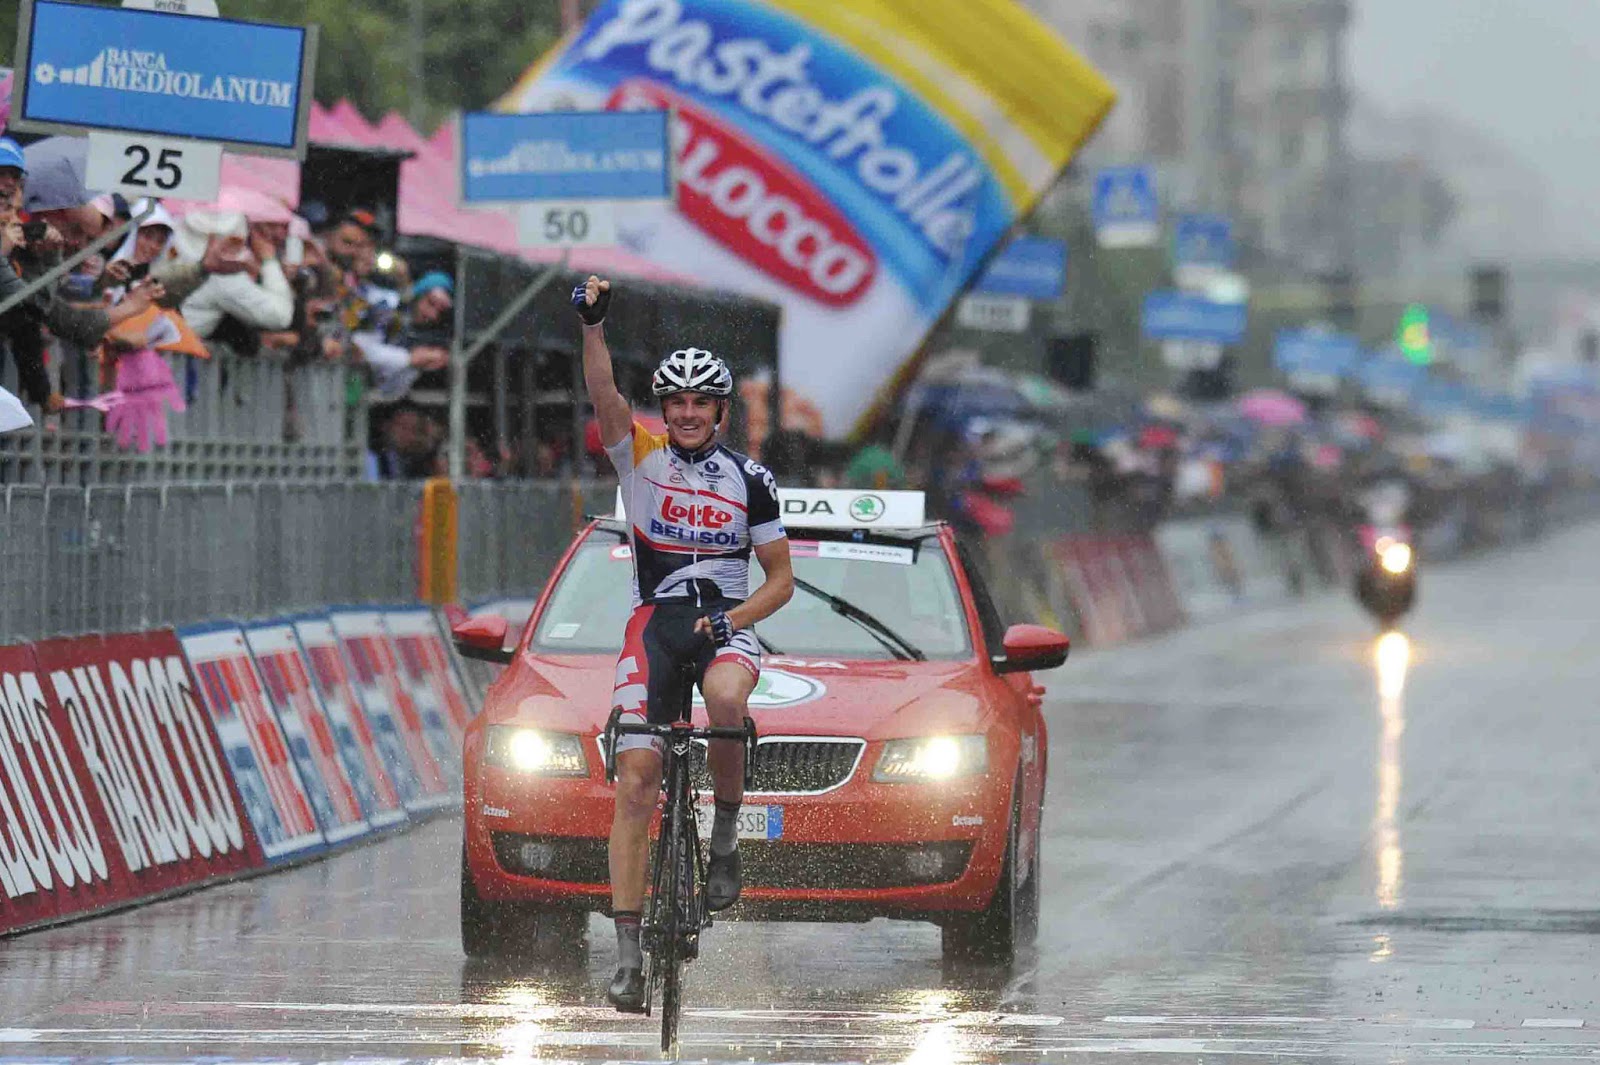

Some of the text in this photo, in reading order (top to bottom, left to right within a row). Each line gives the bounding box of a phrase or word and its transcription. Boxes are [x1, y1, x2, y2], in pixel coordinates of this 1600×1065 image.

[107, 49, 167, 70] BANCA
[105, 66, 293, 107] MEDIOLANUM
[121, 145, 183, 190] 25
[543, 209, 588, 240] 50
[676, 122, 870, 293] LOCCO
[650, 518, 739, 545] BELISOL
